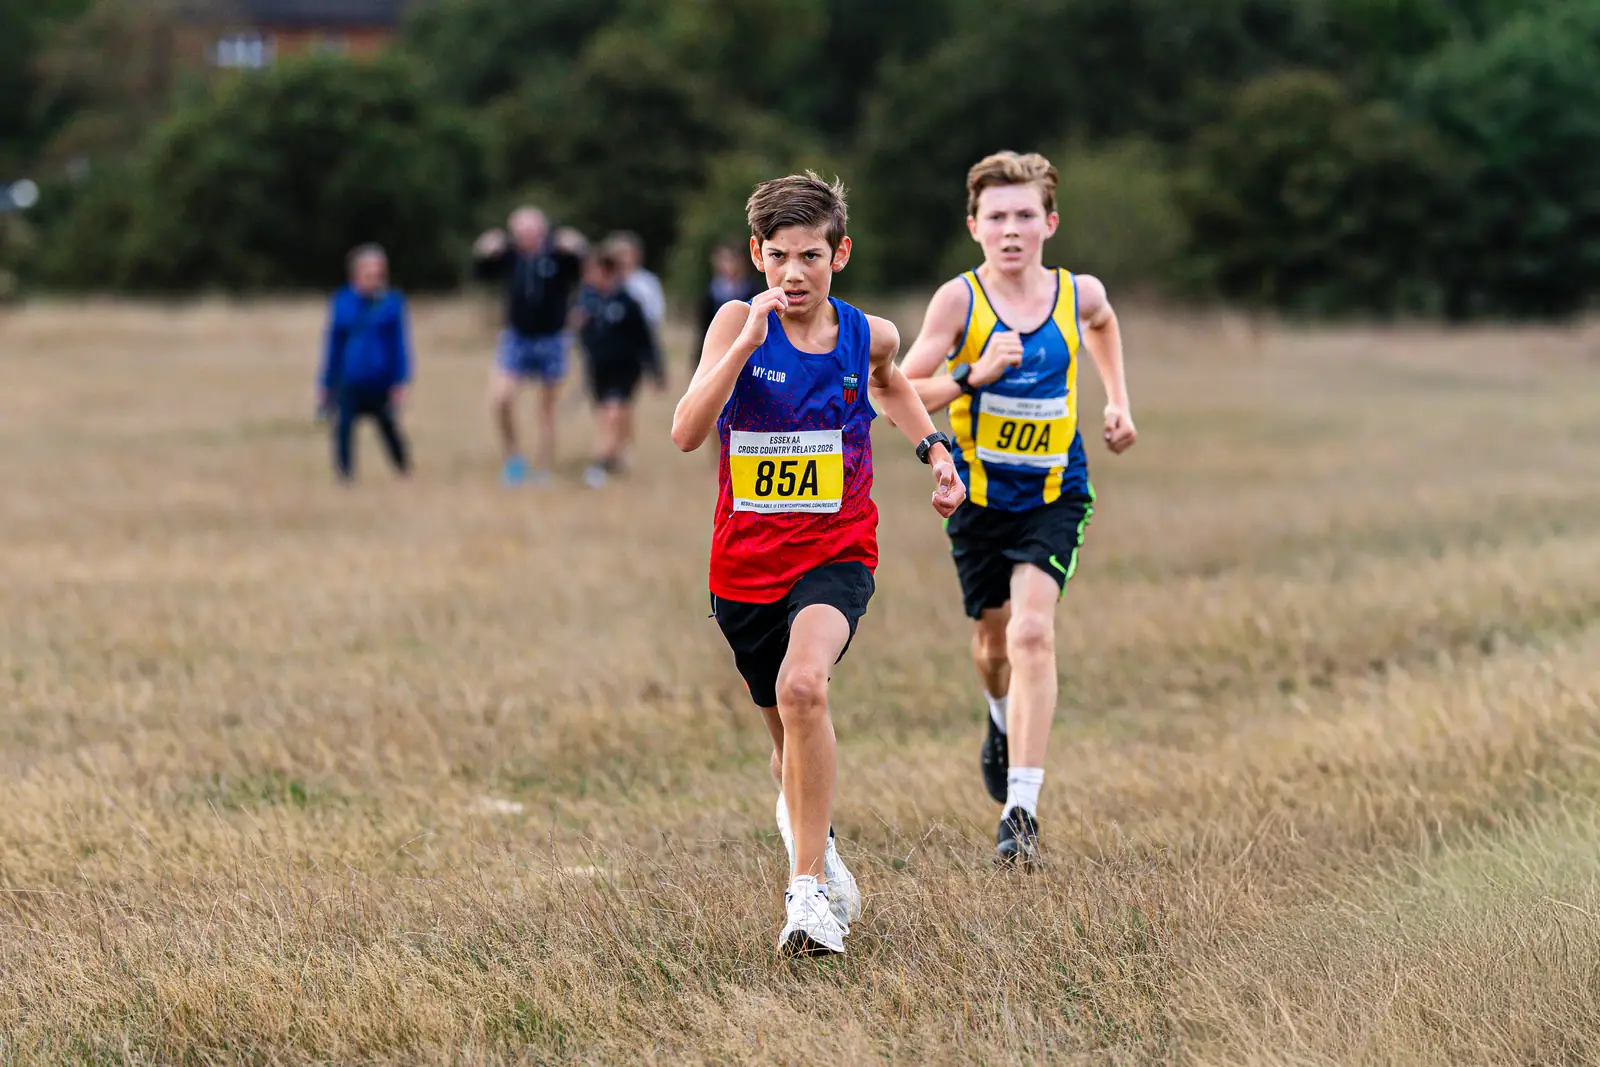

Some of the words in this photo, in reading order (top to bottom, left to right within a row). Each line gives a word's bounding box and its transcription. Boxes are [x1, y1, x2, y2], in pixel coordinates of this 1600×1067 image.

[769, 436, 791, 444] ESSEX
[791, 435, 801, 444] AA
[996, 421, 1051, 453] 90A
[738, 445, 759, 454] CROSS
[759, 446, 791, 455] COUNTRY
[791, 445, 816, 454] RELAYS
[817, 444, 834, 453] 2026
[754, 460, 818, 497] 85A
